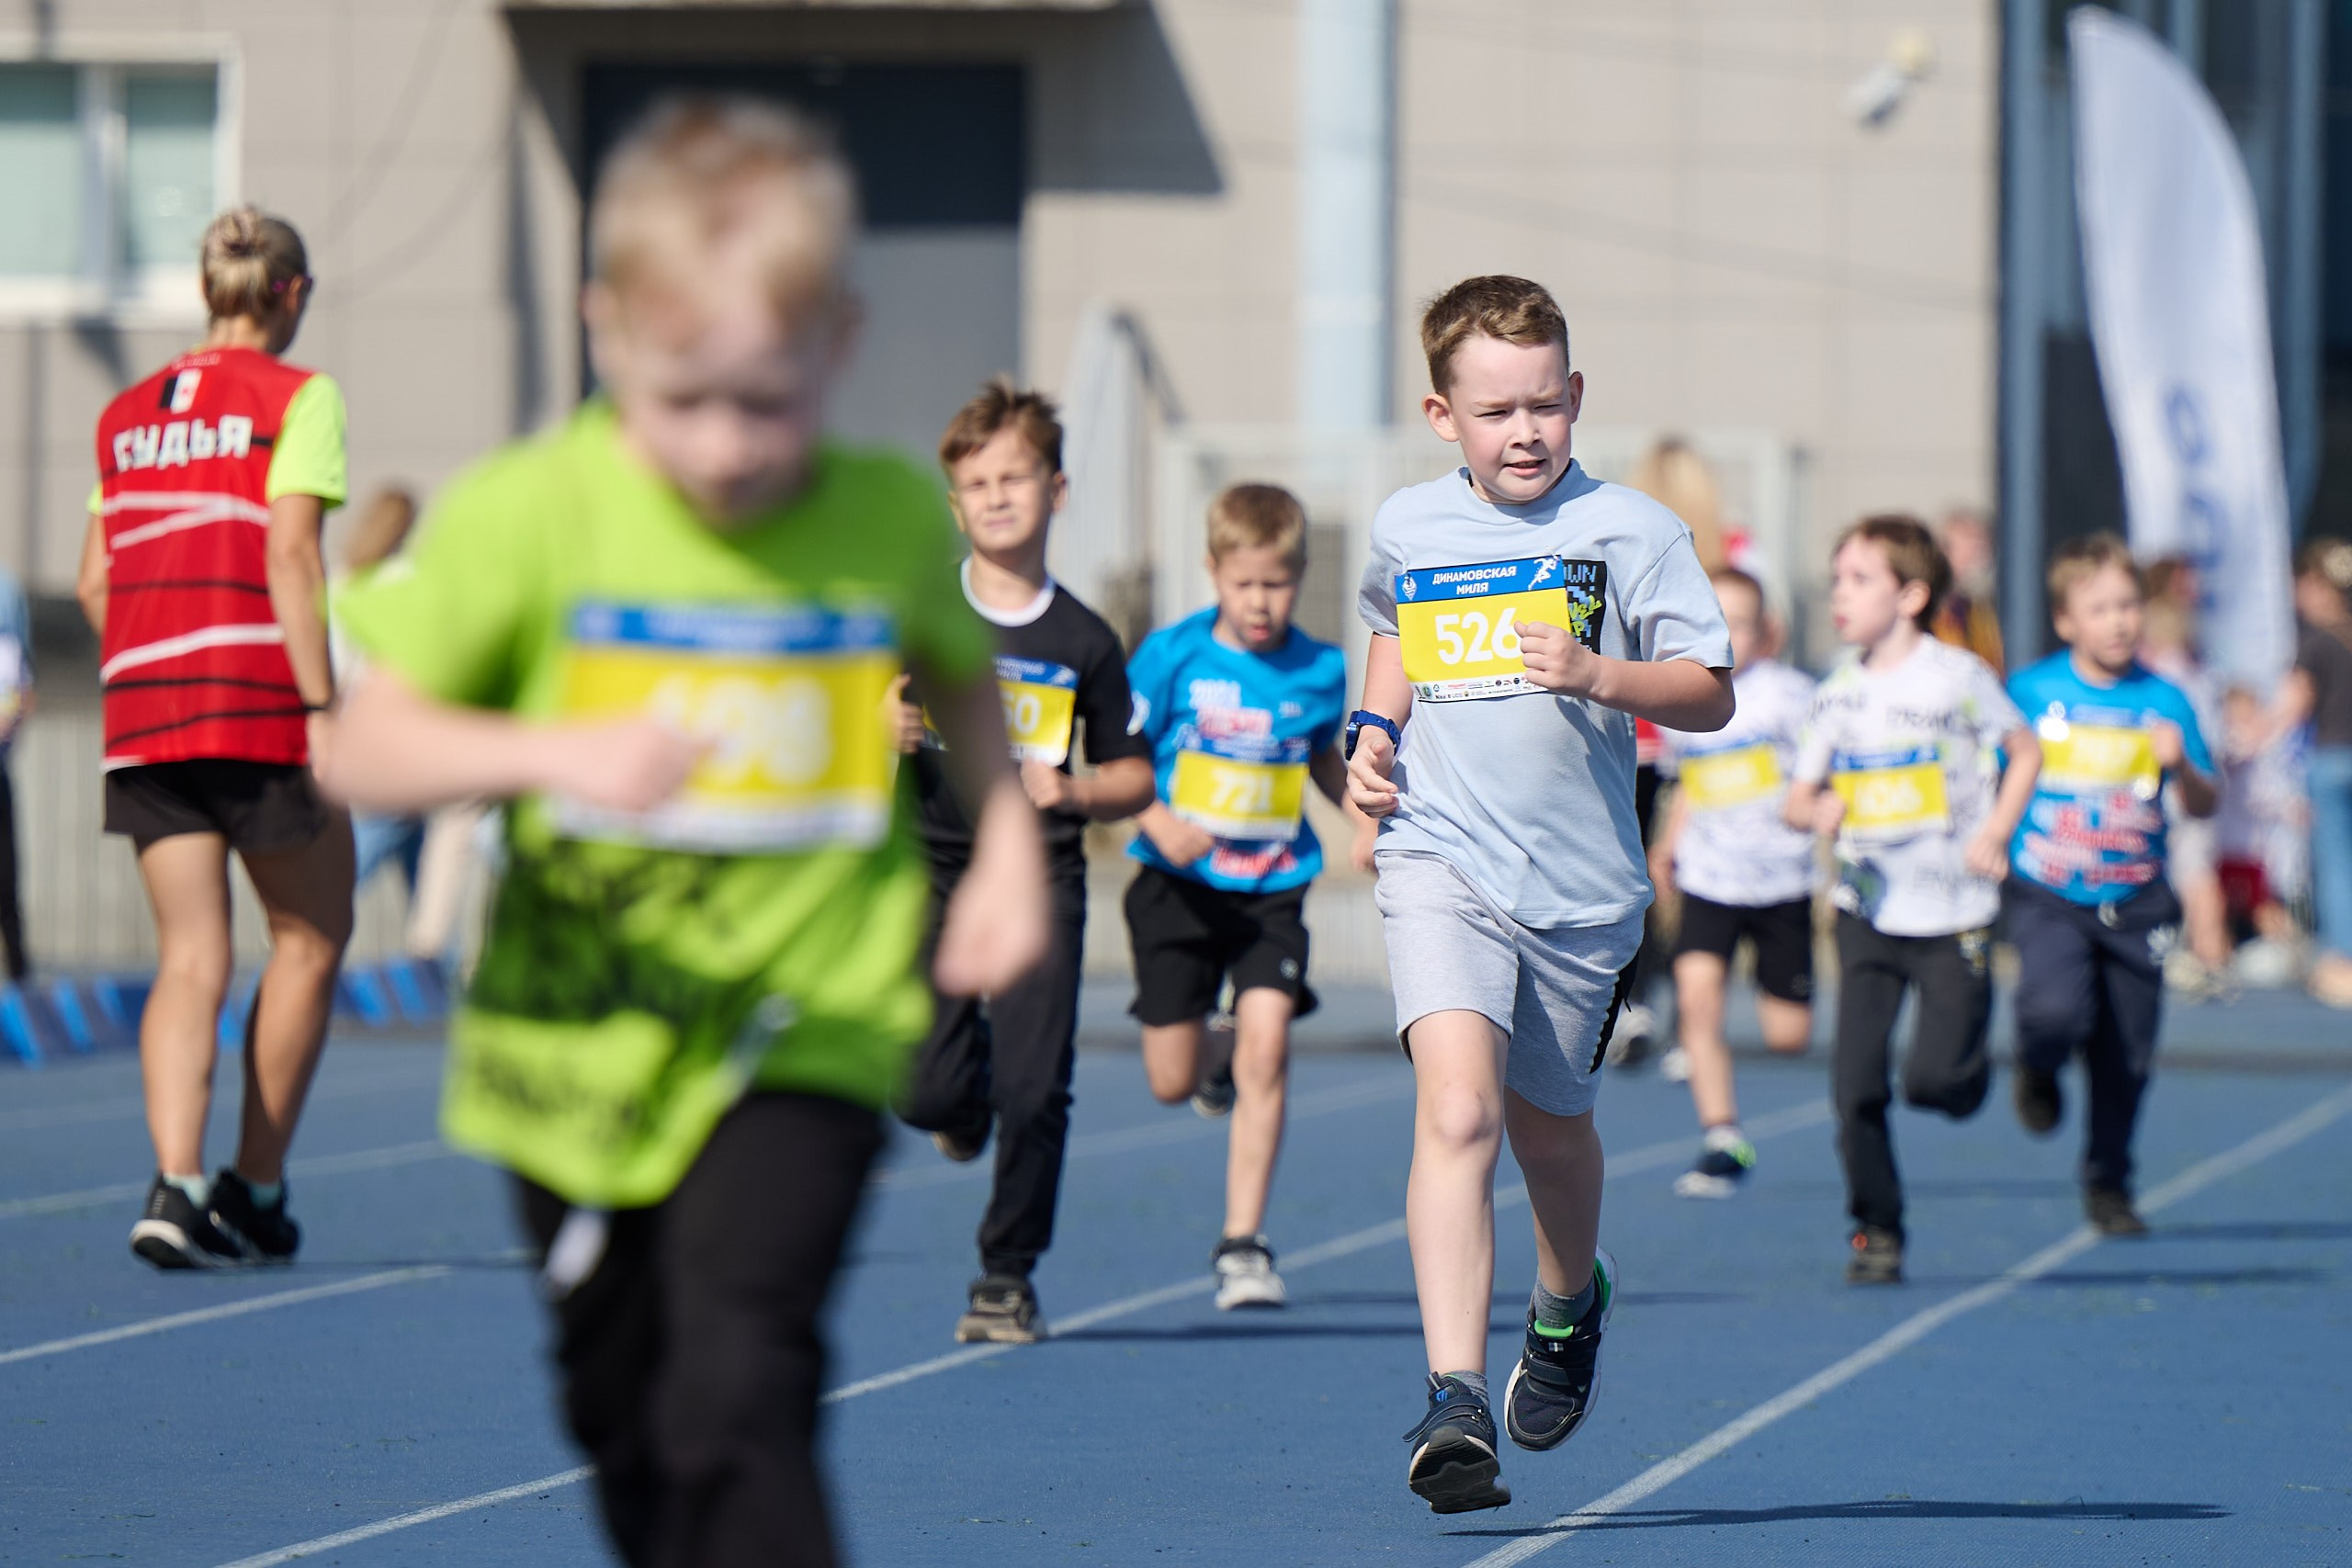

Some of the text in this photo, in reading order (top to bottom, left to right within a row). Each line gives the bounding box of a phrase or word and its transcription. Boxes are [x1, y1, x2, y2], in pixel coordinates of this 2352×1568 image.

[113, 414, 254, 473] СУДЬЯ
[1432, 566, 1517, 584] ДИНАМОВСКАЯ
[1456, 581, 1489, 595] МИЛЯ
[1435, 607, 1524, 665] 526
